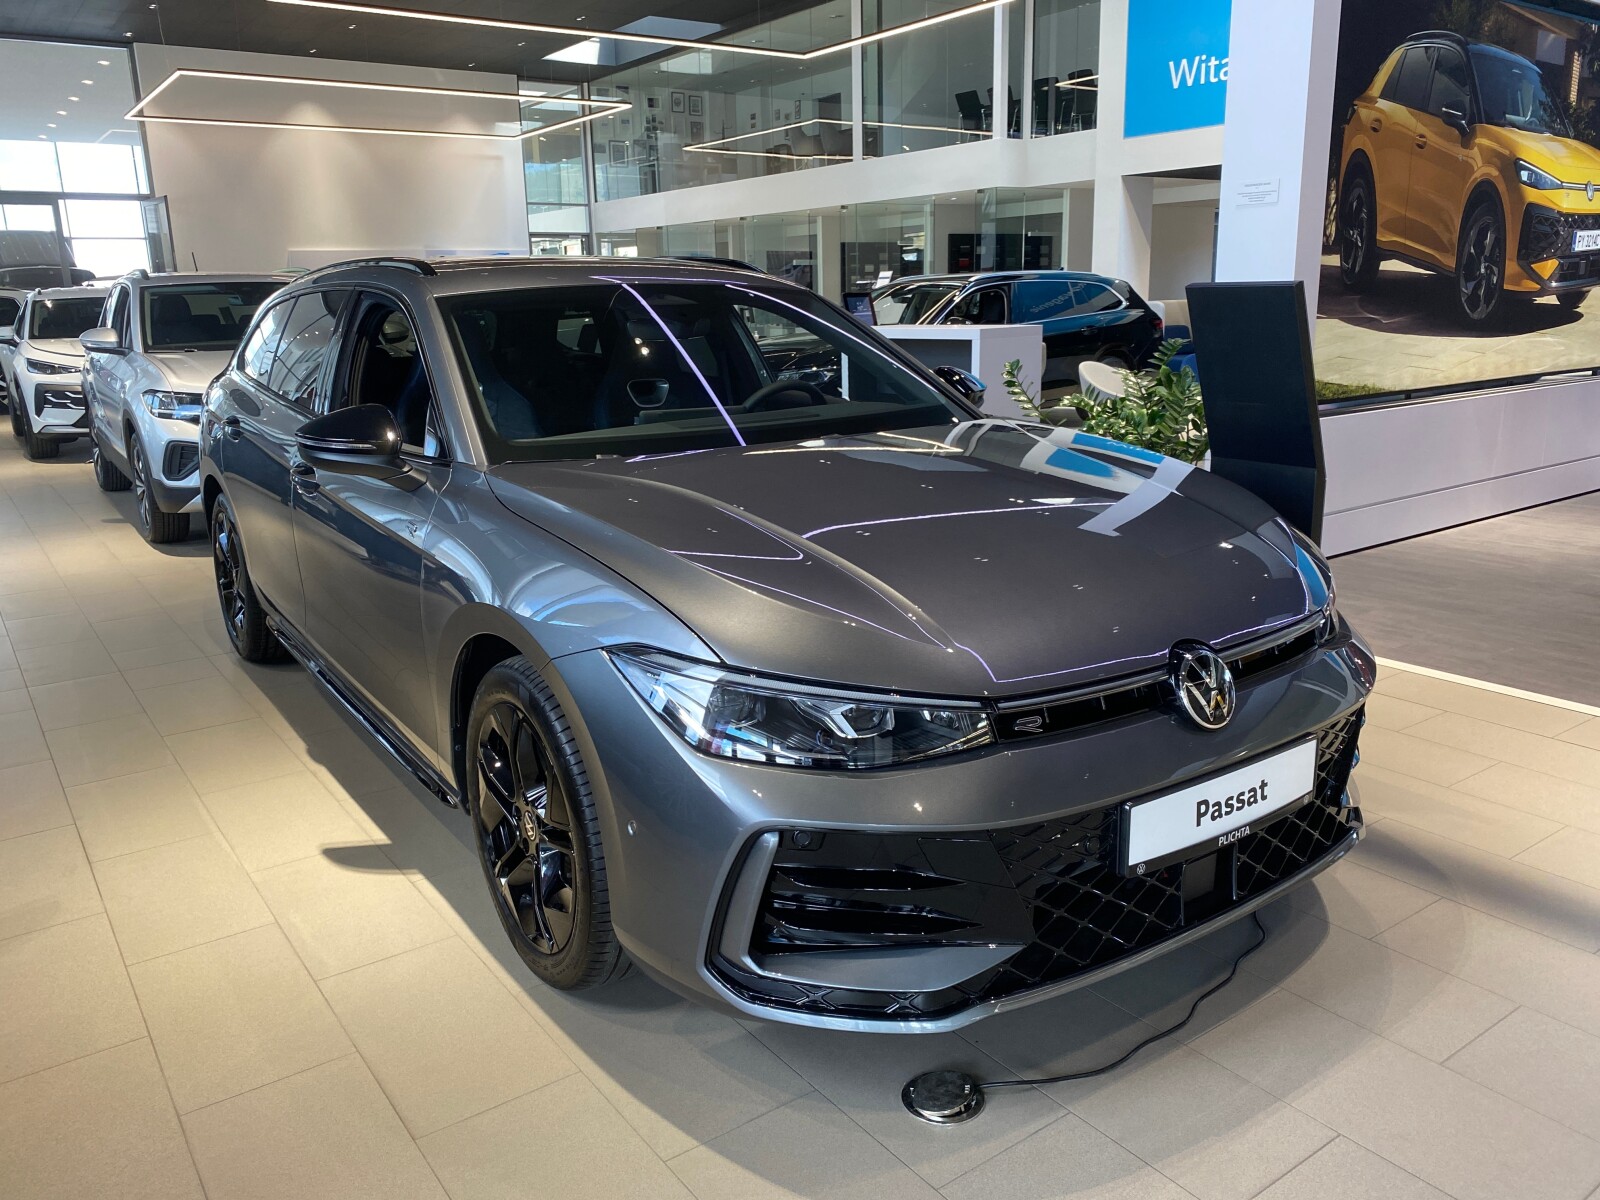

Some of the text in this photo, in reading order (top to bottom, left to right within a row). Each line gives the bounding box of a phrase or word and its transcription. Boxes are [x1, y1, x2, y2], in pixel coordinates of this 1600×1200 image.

[1168, 54, 1230, 89] Wita
[1195, 778, 1269, 828] Passat
[1218, 825, 1250, 847] PLICHTA
